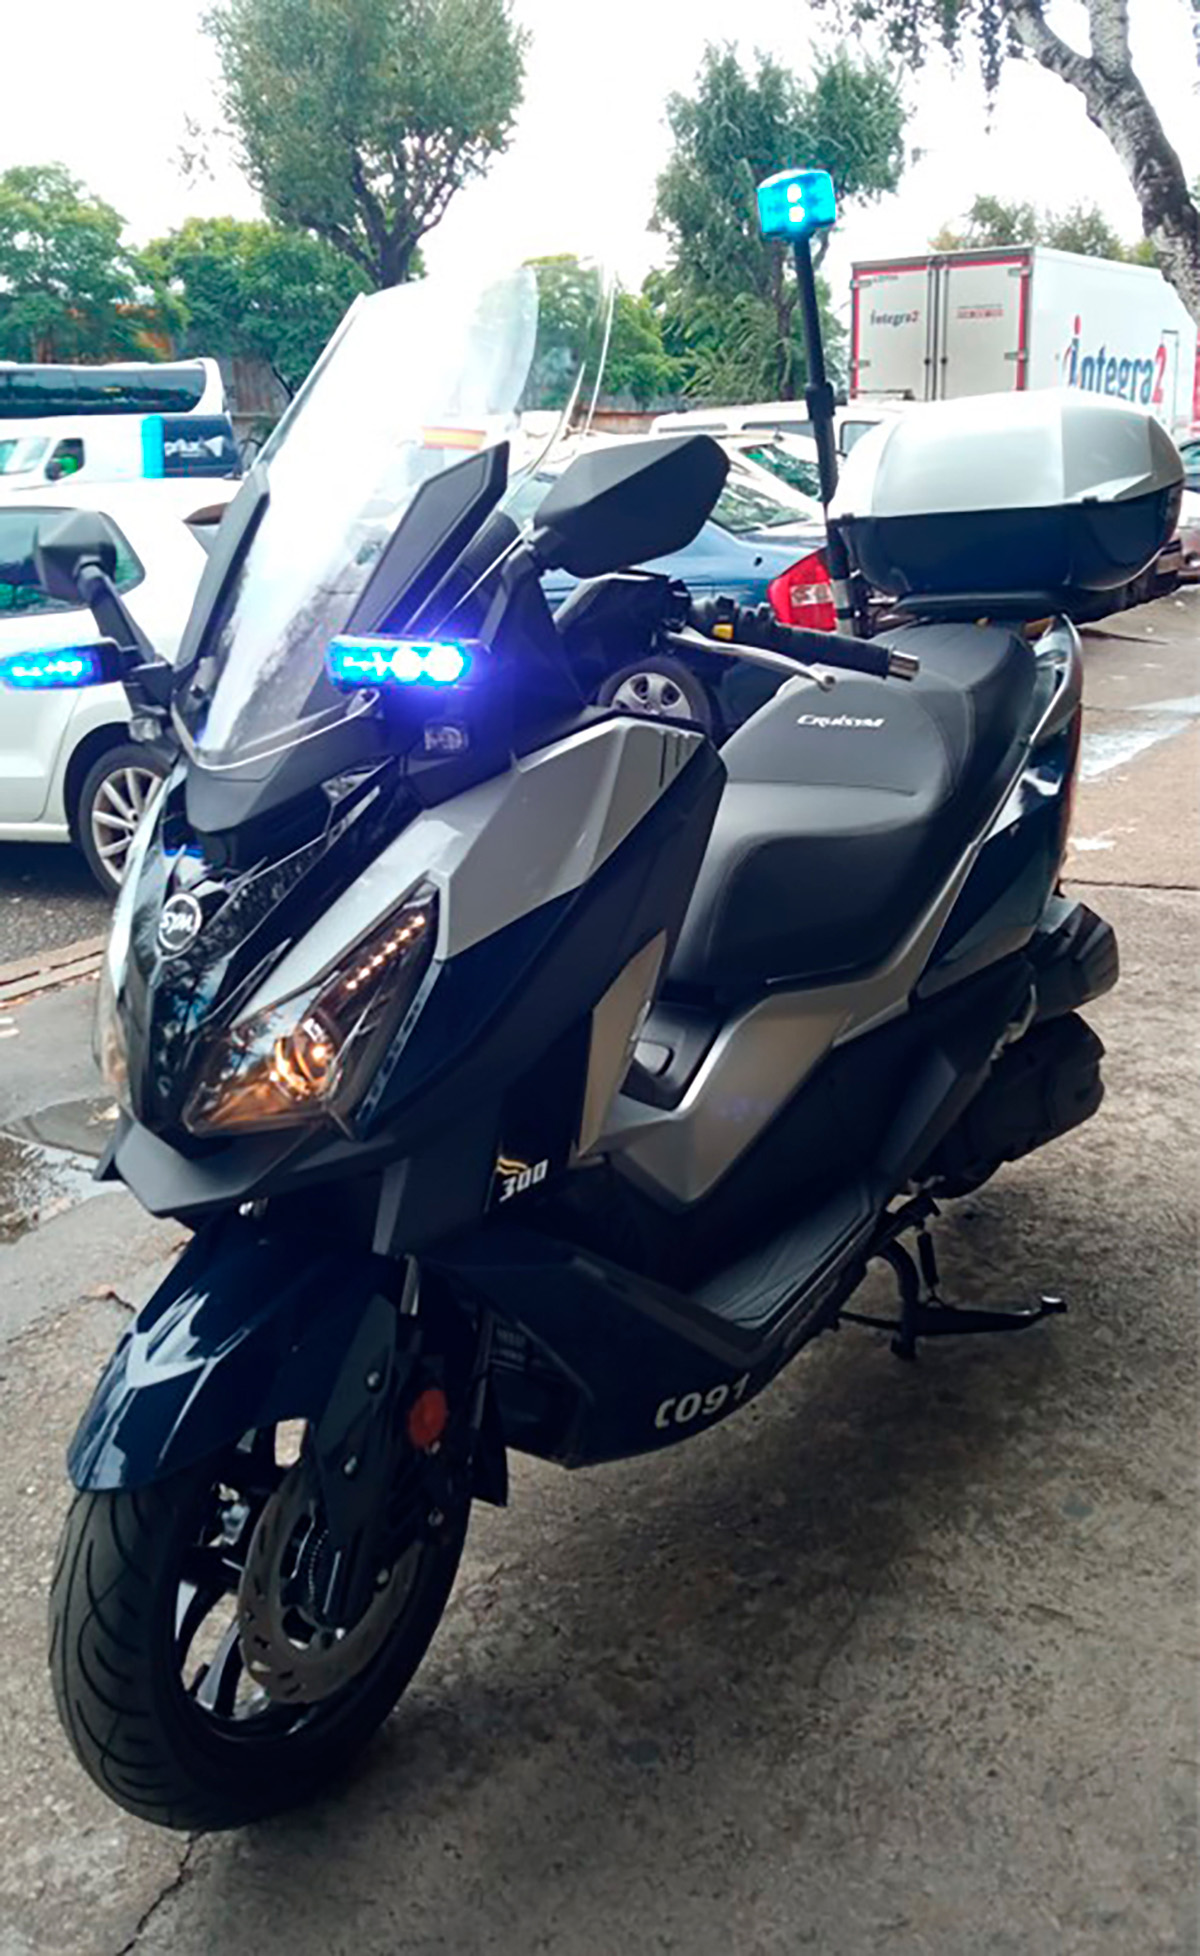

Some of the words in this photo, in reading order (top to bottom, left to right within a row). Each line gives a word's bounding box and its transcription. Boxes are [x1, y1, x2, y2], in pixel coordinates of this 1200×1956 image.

[1066, 314, 1167, 405] integra2
[159, 911, 194, 935] SYM
[499, 1158, 549, 1203] 300
[654, 1372, 751, 1430] C091
